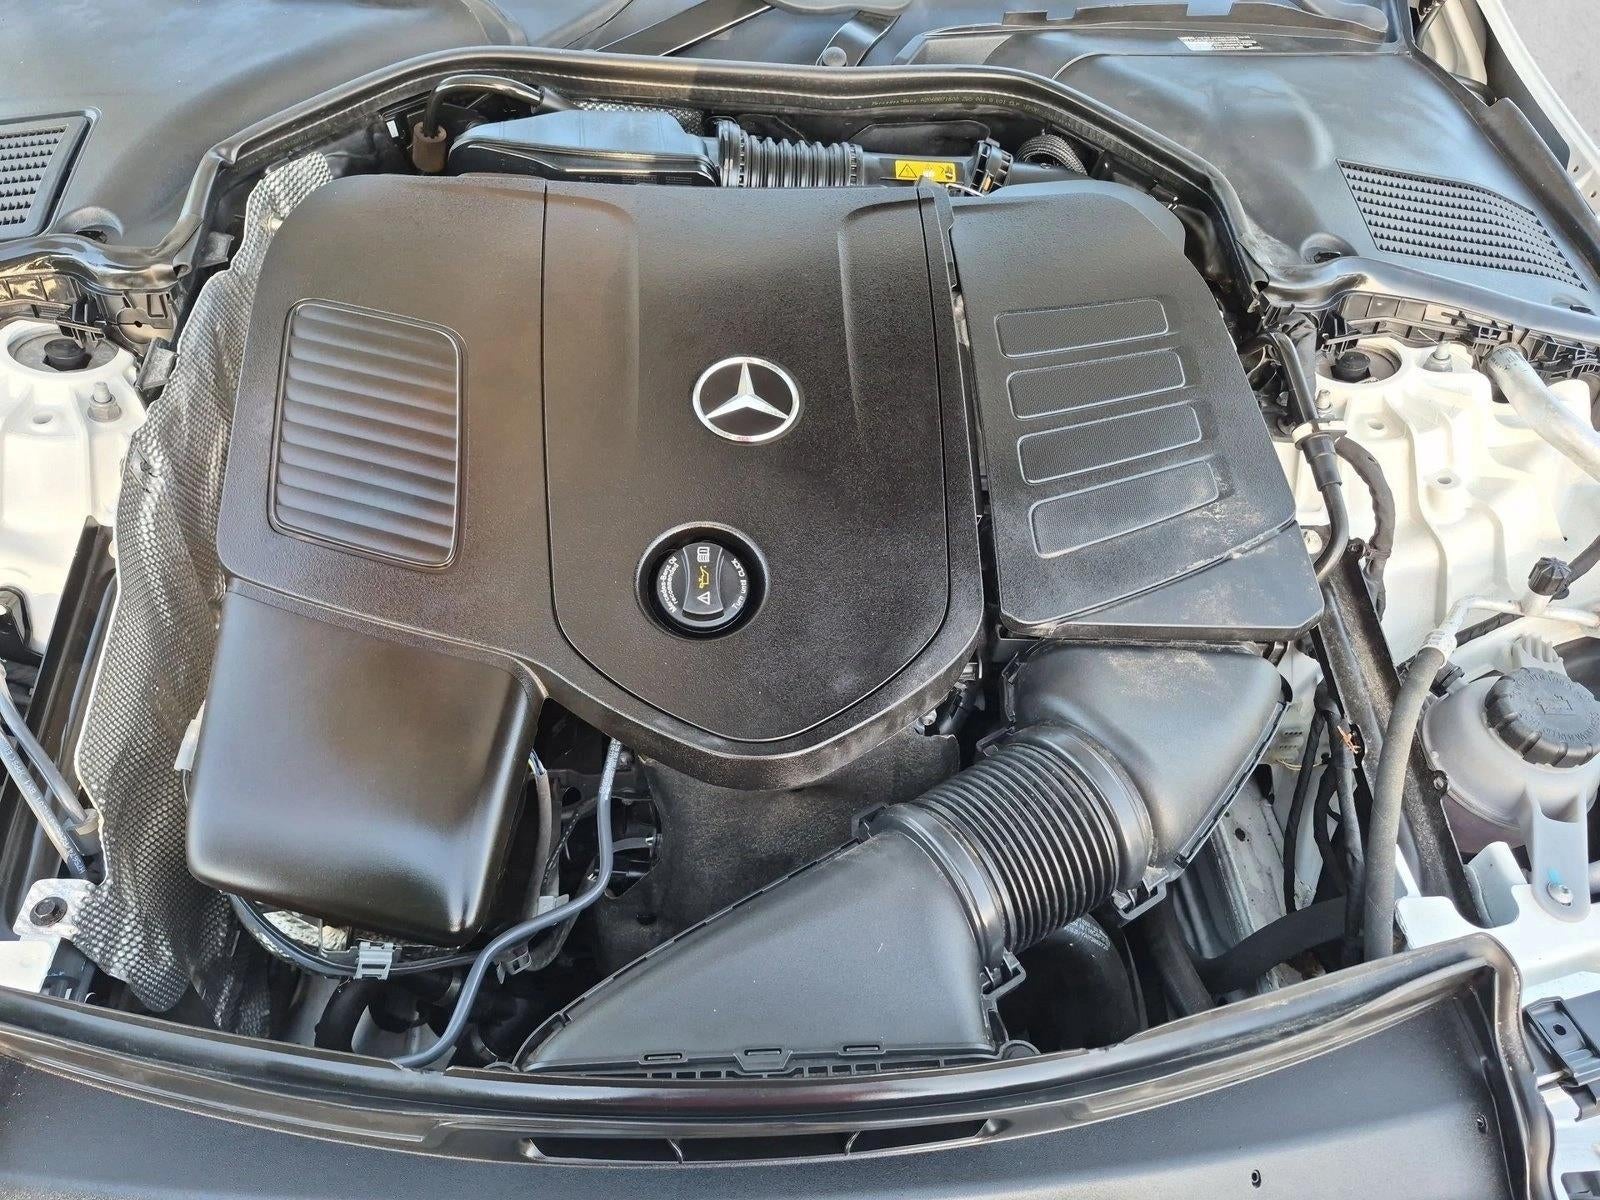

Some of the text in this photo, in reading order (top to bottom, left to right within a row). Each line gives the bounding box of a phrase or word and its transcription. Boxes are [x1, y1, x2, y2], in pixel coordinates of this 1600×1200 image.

[731, 558, 746, 578] CLICK
[660, 564, 678, 613] Mercedes-Benz
[667, 563, 680, 605] recommended
[732, 595, 745, 610] Turn
